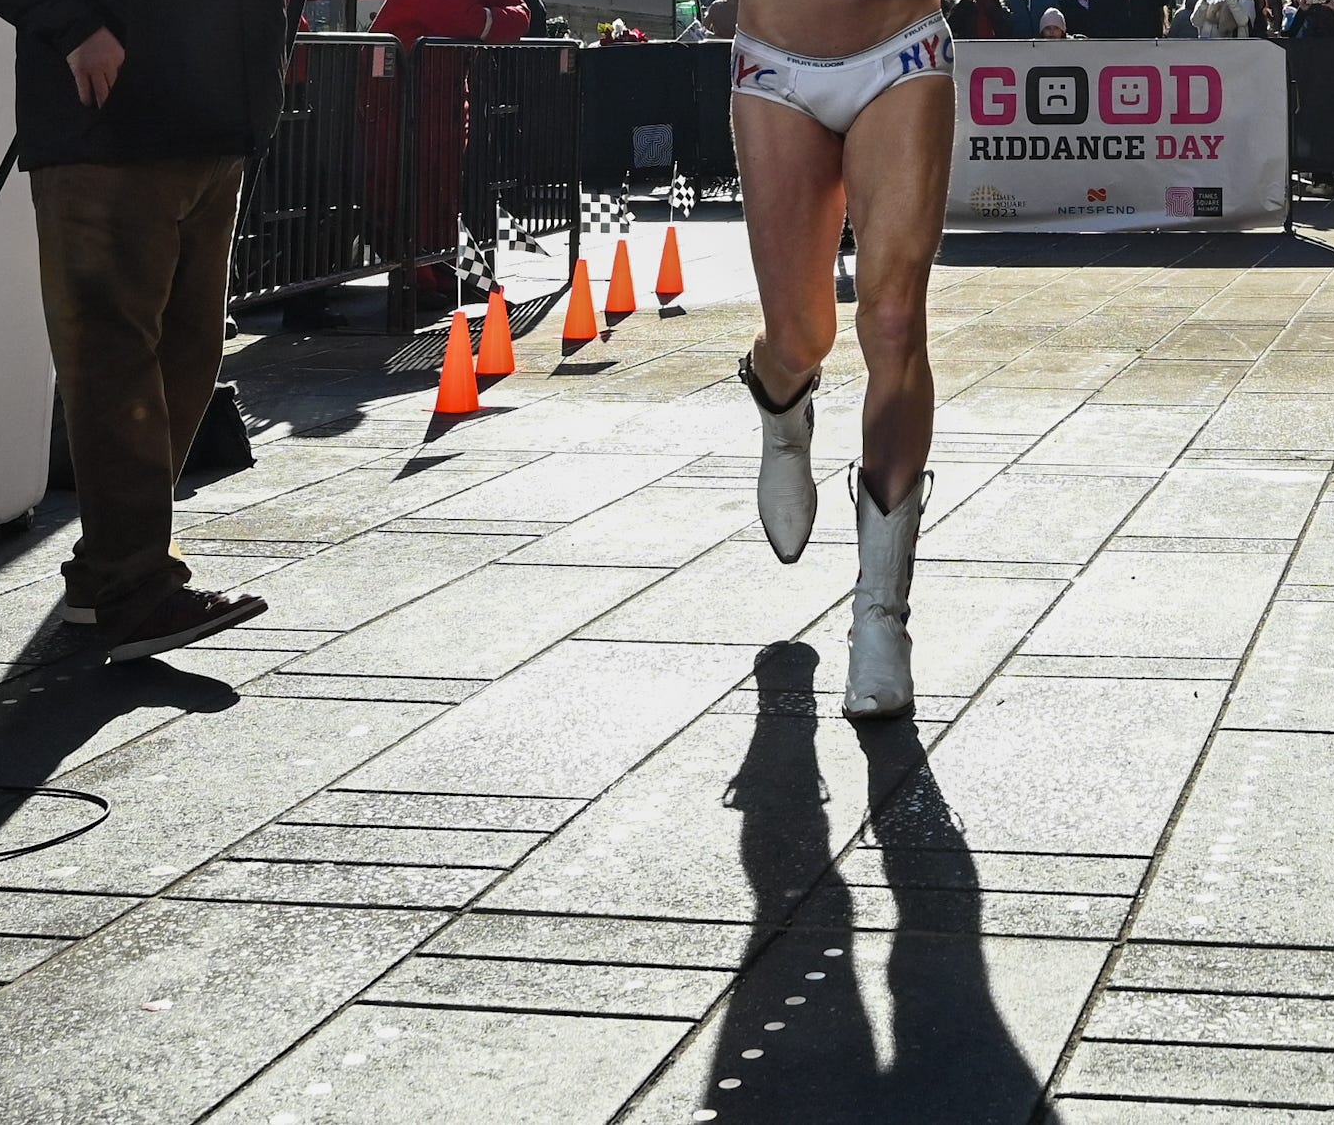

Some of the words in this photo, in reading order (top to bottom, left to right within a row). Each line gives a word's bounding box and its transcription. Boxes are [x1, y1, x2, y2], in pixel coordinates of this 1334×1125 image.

[787, 56, 811, 67] FRUIT
[820, 60, 844, 68] LOOM
[733, 53, 777, 91] YC
[969, 65, 1223, 125] GOOD
[969, 135, 1145, 161] RIDDANCE
[1155, 135, 1225, 160] DAY
[982, 209, 1017, 217] 2023
[1058, 206, 1135, 215] NETSPEND
